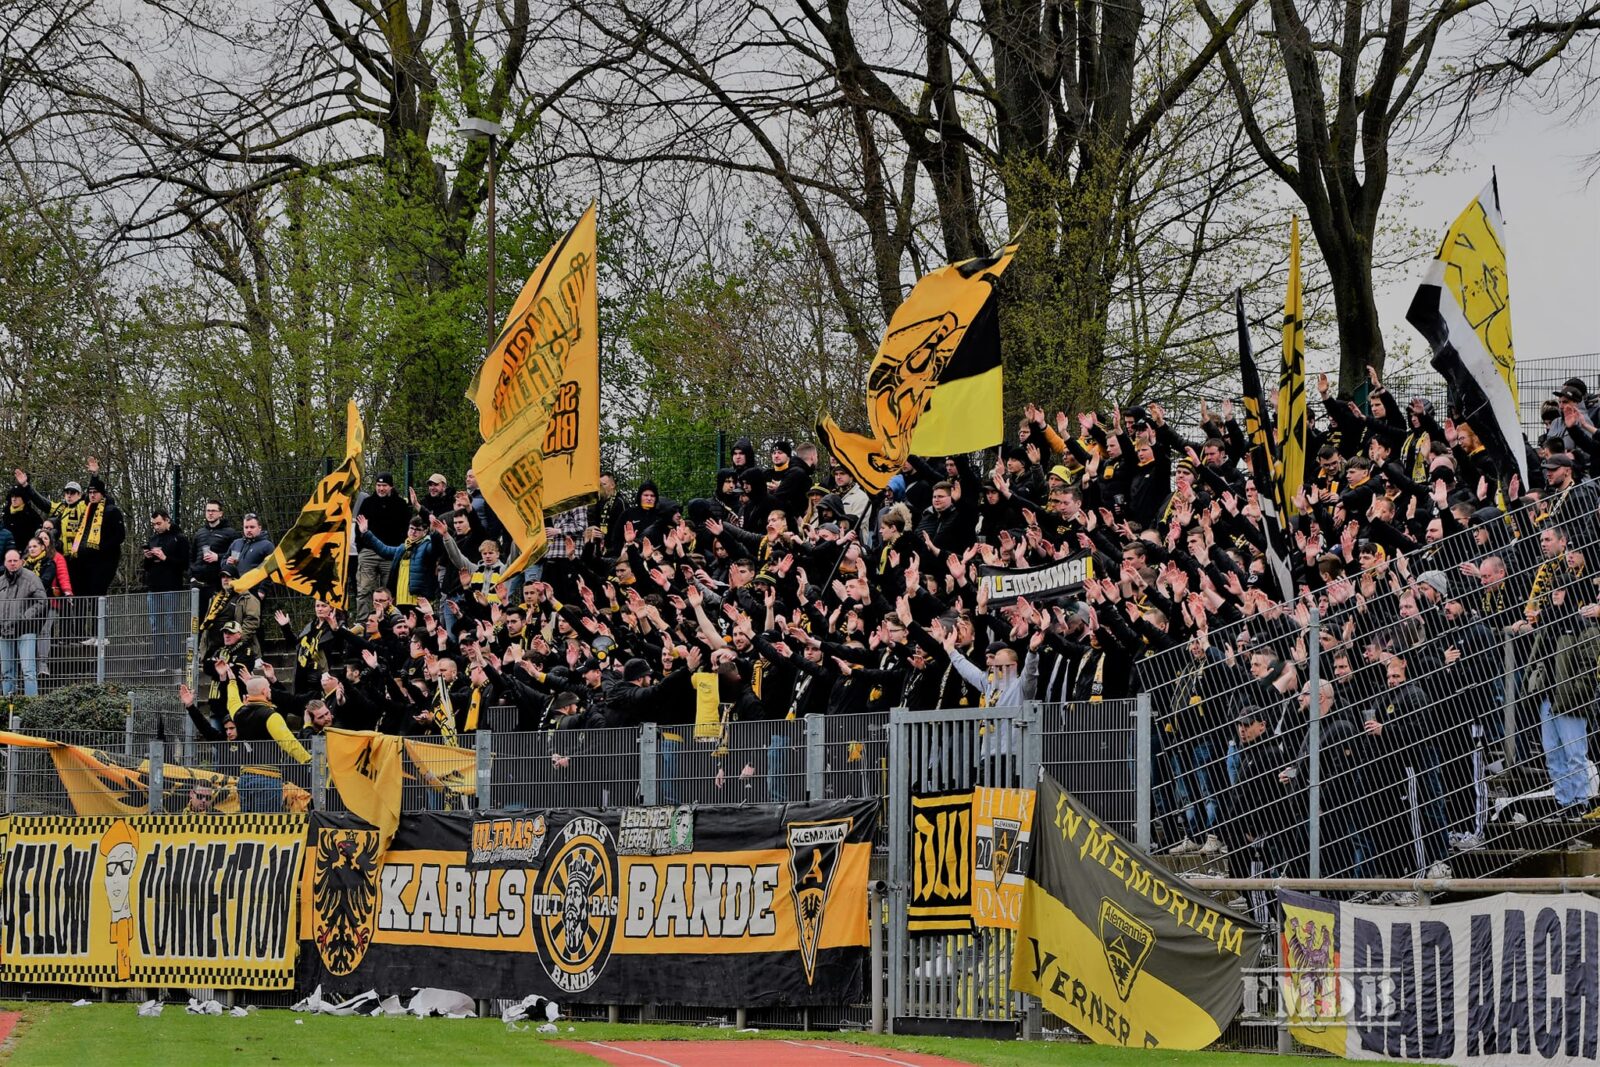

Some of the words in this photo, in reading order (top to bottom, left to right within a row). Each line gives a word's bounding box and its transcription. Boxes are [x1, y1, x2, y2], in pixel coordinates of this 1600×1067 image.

[473, 819, 533, 850] ULTRAS
[563, 819, 608, 844] KARLS
[1054, 791, 1082, 842] IN
[1079, 818, 1246, 957] MEMORIAM
[3, 843, 98, 955] YELLOW
[139, 842, 300, 959] CONNECTION
[378, 864, 527, 937] KARLS
[624, 864, 780, 938] BANDE
[1104, 905, 1148, 944] Alemannia
[552, 965, 597, 990] BANDE
